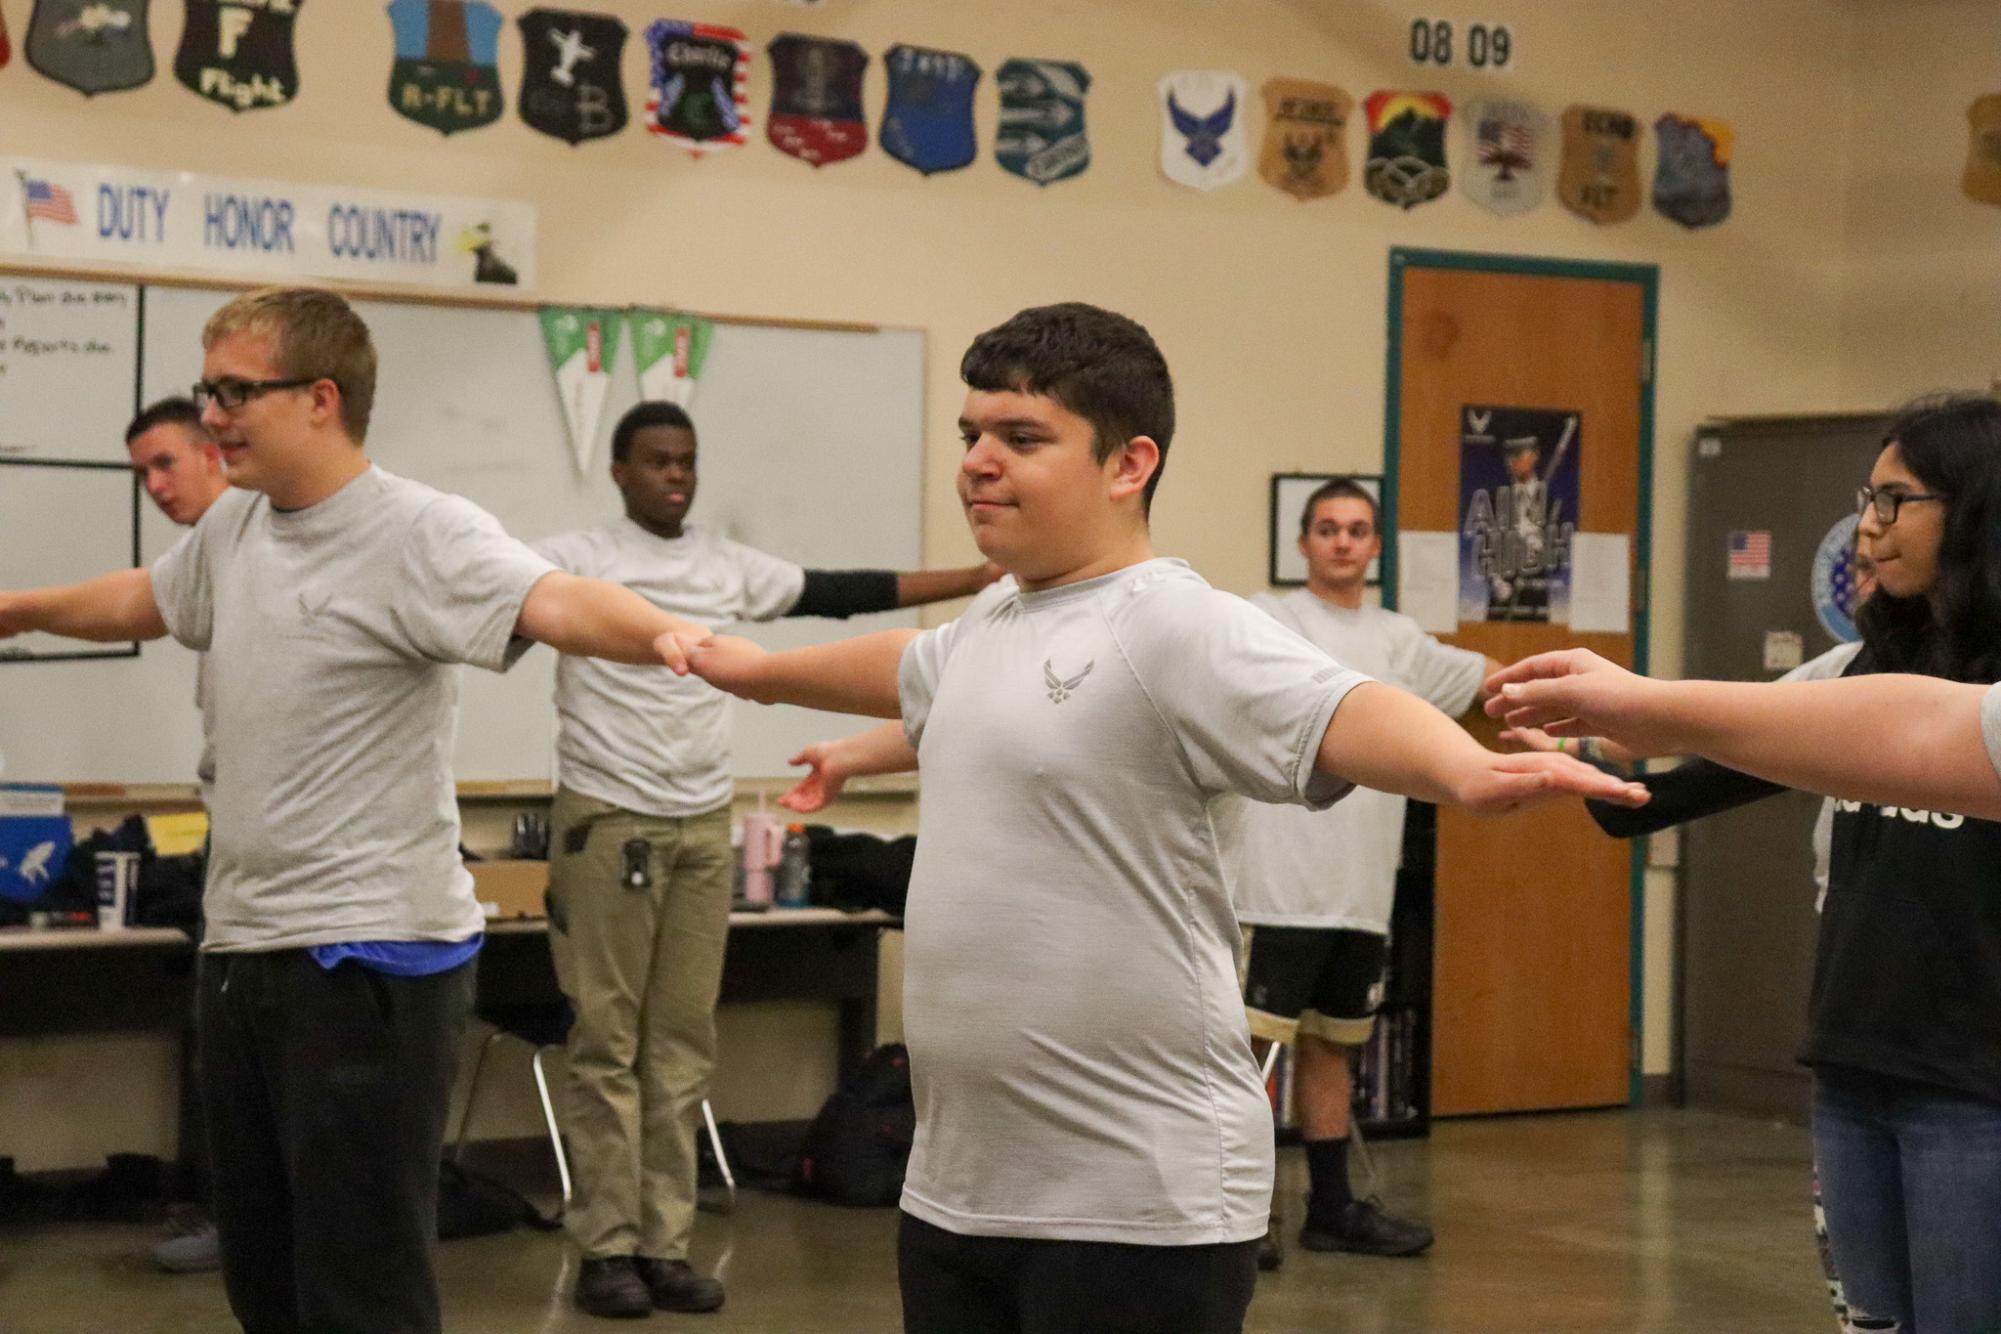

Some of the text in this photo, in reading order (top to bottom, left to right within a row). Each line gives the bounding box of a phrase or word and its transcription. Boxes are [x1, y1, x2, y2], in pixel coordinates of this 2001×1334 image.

[219, 6, 254, 58] F
[1411, 18, 1510, 67] 08 09
[201, 67, 286, 107] Flight
[97, 183, 442, 266] DUTY HONOR COUNTRY
